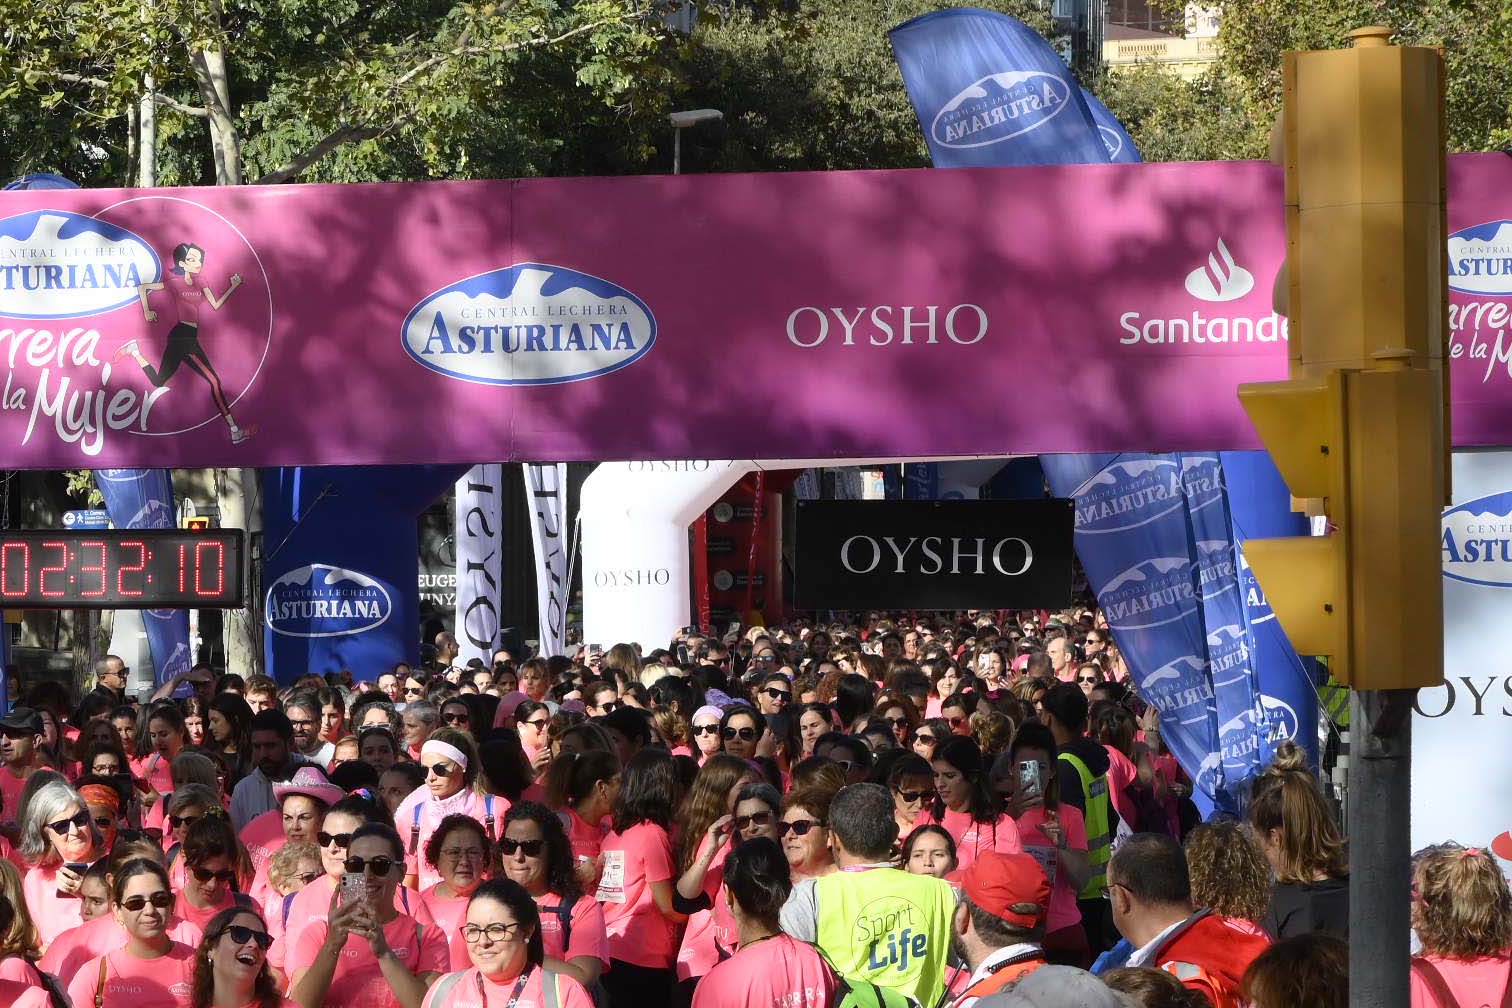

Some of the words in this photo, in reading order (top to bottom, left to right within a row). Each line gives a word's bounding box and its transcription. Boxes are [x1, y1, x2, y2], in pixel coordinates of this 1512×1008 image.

[64, 246, 137, 258] LECHERA
[460, 306, 540, 319] CENTRAL
[547, 304, 629, 318] LECHERA
[787, 303, 989, 348] OYSHO
[1119, 310, 1289, 345] Santand
[420, 310, 637, 356] ASTURIANA
[2, 372, 28, 411] la
[22, 363, 171, 457] Mujer
[1, 542, 223, 596] 02:32:10
[840, 535, 1034, 576] OYSHO
[595, 568, 671, 588] OYSHO
[269, 593, 382, 622] ASTURIANA
[857, 903, 915, 942] Sport
[868, 928, 928, 972] Life
